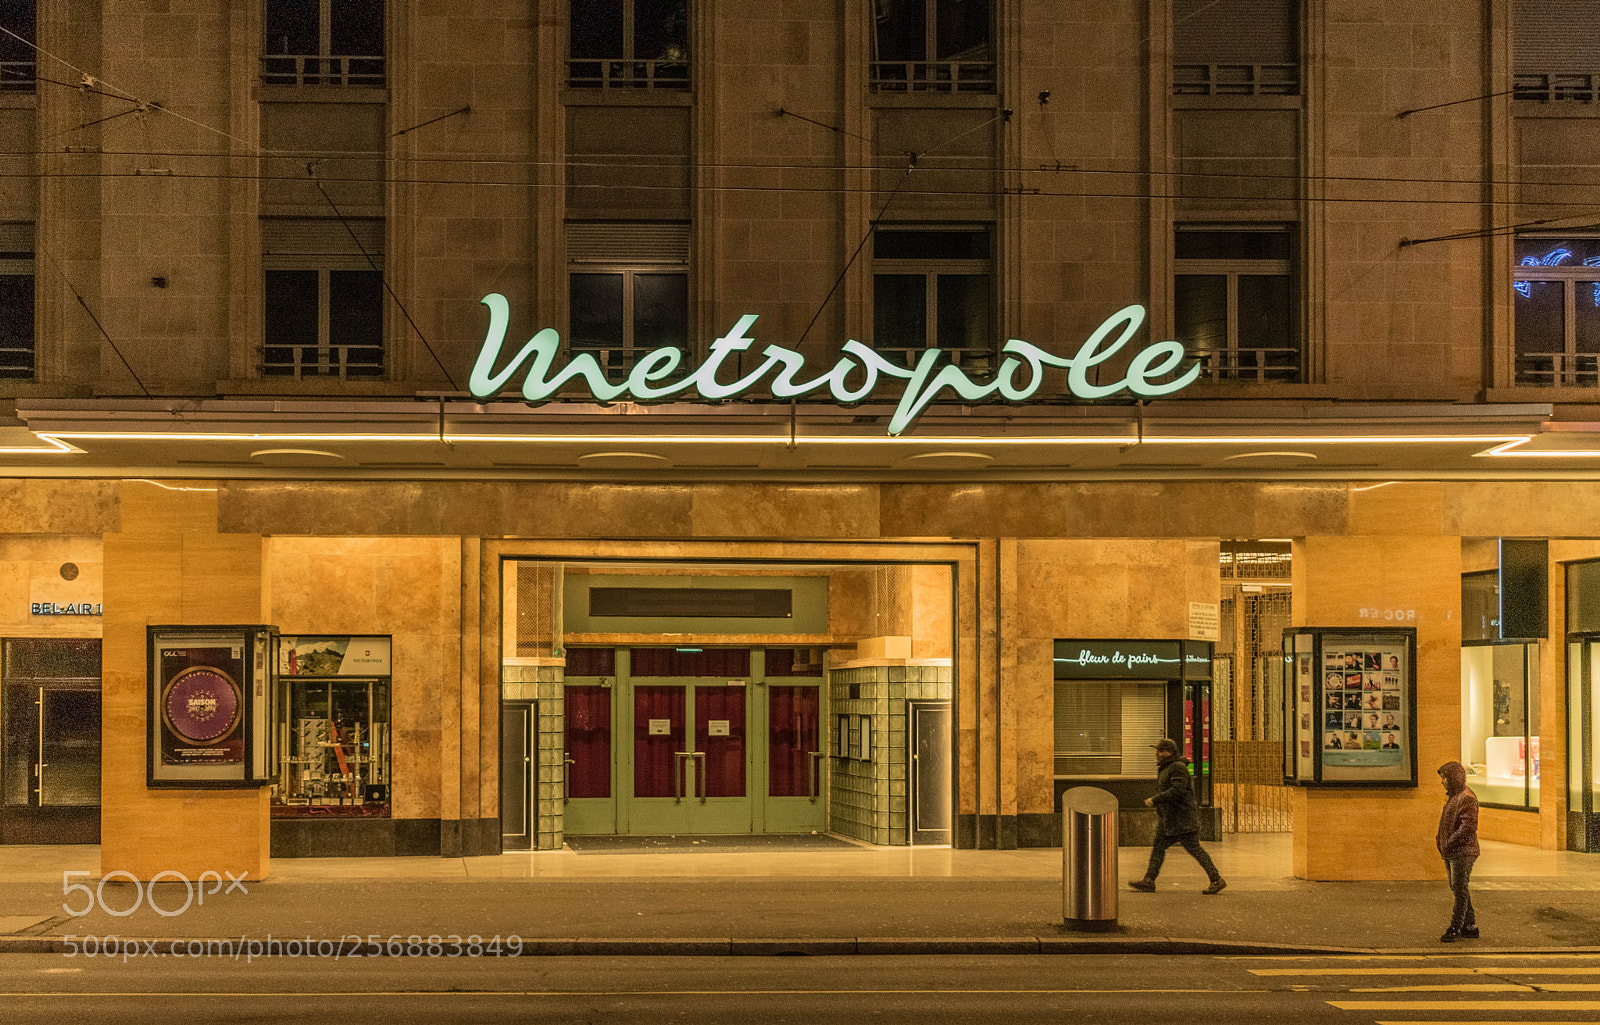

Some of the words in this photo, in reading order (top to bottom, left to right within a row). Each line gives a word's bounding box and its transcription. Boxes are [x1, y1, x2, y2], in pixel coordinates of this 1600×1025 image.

[31, 602, 93, 616] BEL-AIR
[1078, 649, 1109, 666] fleur
[1112, 650, 1126, 664] de
[1127, 653, 1158, 669] pains
